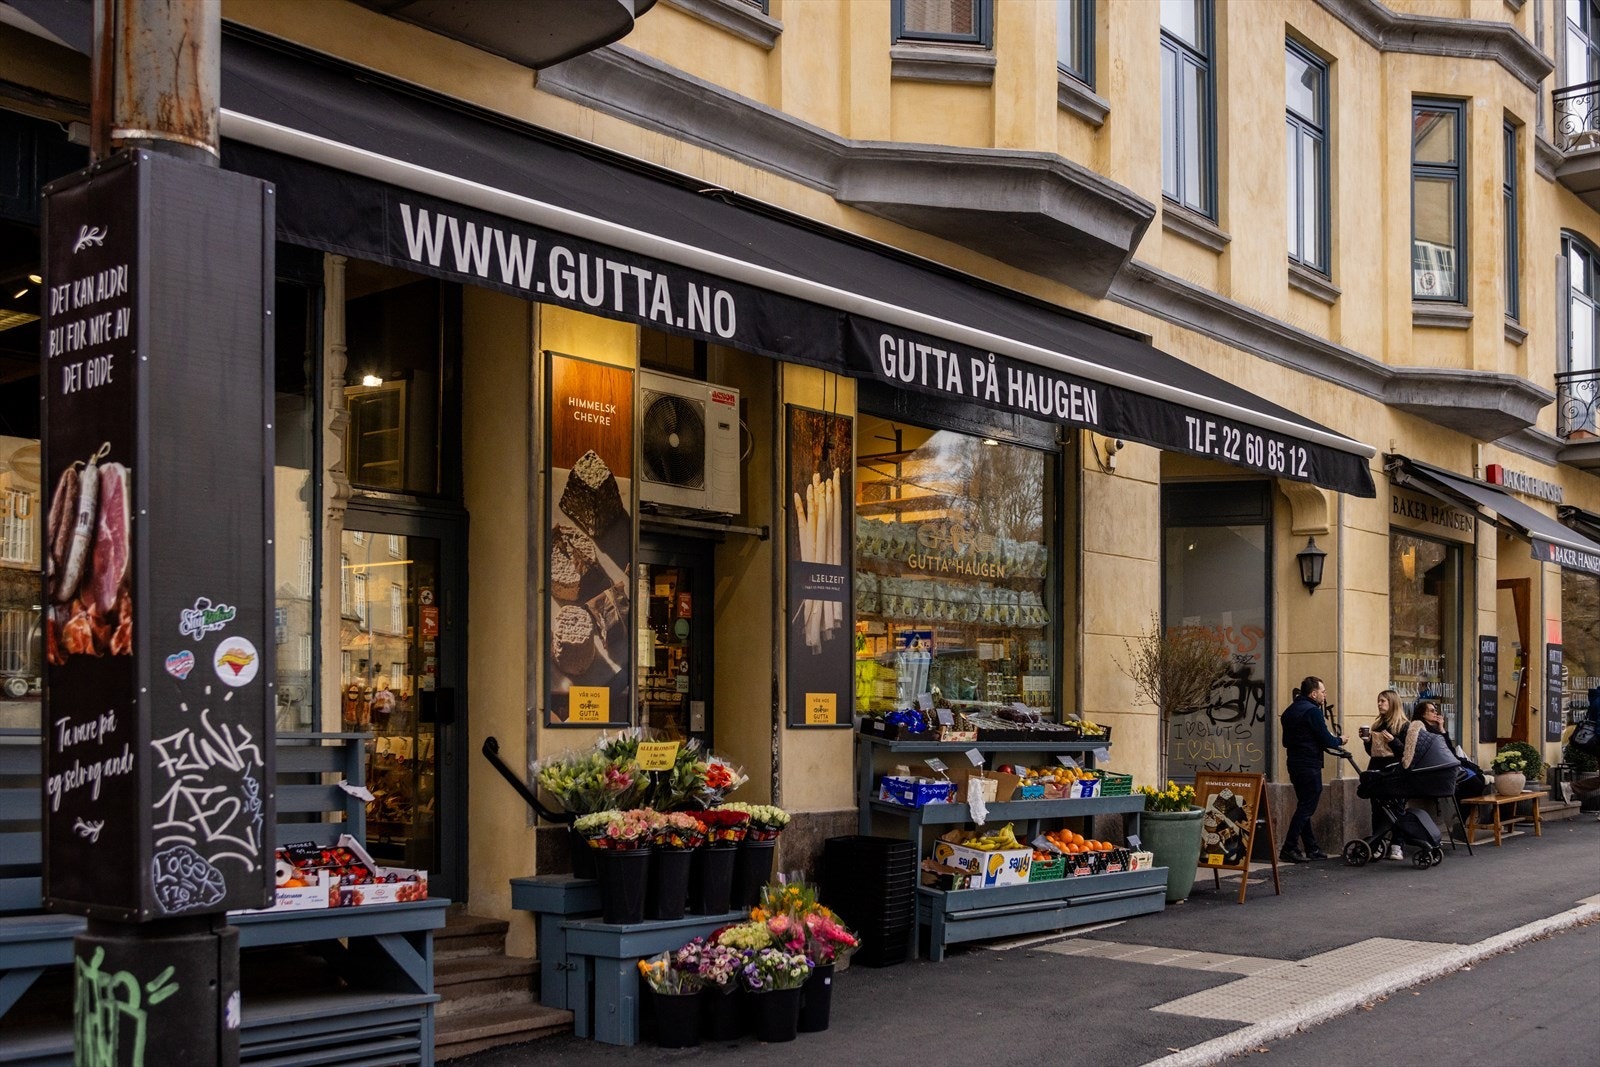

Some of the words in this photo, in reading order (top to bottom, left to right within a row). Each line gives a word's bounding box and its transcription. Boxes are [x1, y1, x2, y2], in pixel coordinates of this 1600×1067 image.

[51, 283, 71, 316] DET
[73, 276, 95, 309] KAN
[96, 264, 128, 302] ALDRI
[400, 203, 736, 338] WWW.GUTTA.NO
[49, 326, 64, 358] BLI
[66, 318, 87, 352] FOR
[90, 312, 112, 346] MYE
[114, 307, 131, 339] AV
[63, 362, 83, 395] DET
[86, 354, 114, 389] GODE
[879, 333, 963, 395] GUTTA
[971, 352, 1000, 403] PÅ
[1007, 367, 1099, 425] HAUGEN
[568, 396, 616, 414] HIMMELSK
[573, 411, 611, 426] CHEVRE
[1185, 415, 1219, 454] TLF.
[1223, 425, 1241, 461] 22
[1245, 432, 1264, 467] 60
[1268, 439, 1285, 472] 85
[1289, 445, 1308, 477] 12
[1393, 495, 1428, 522] BAKER
[1431, 506, 1473, 533] HANSEN
[908, 554, 949, 573] GUTTA
[956, 559, 1005, 578] HAUGEN
[1555, 546, 1578, 566] BAKER
[1578, 552, 1600, 573] HANSE
[55, 716, 72, 752] Ta
[72, 720, 98, 744] vare
[98, 709, 118, 745] på
[1196, 721, 1252, 741] SLUTS
[1201, 742, 1263, 766] SLUTS
